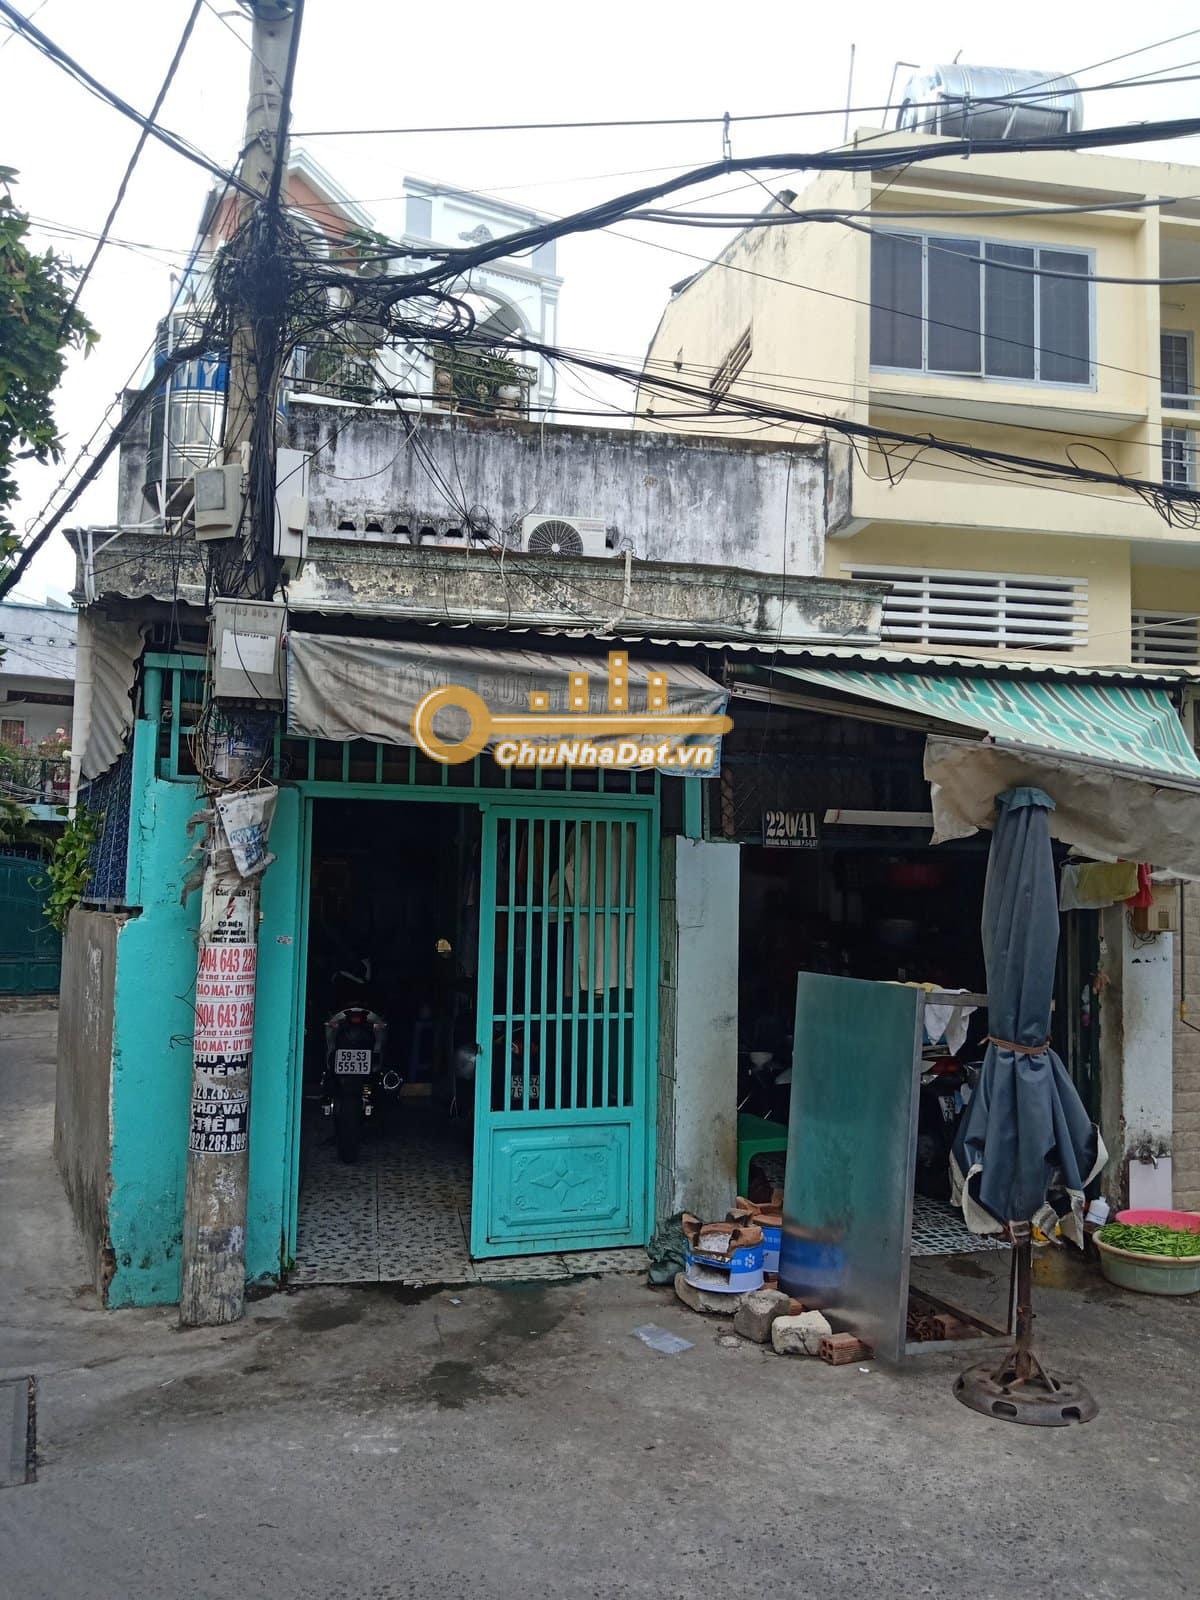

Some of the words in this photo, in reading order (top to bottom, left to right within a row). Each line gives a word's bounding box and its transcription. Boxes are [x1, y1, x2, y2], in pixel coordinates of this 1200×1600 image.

[220, 948, 240, 973] 643
[235, 983, 245, 996] UY
[218, 1003, 237, 1028] 643
[233, 1038, 243, 1051] UY
[341, 1051, 367, 1061] 59-S3
[338, 1062, 369, 1072] 555.15
[222, 1102, 248, 1115] VAY
[195, 1114, 240, 1133] TIỀN
